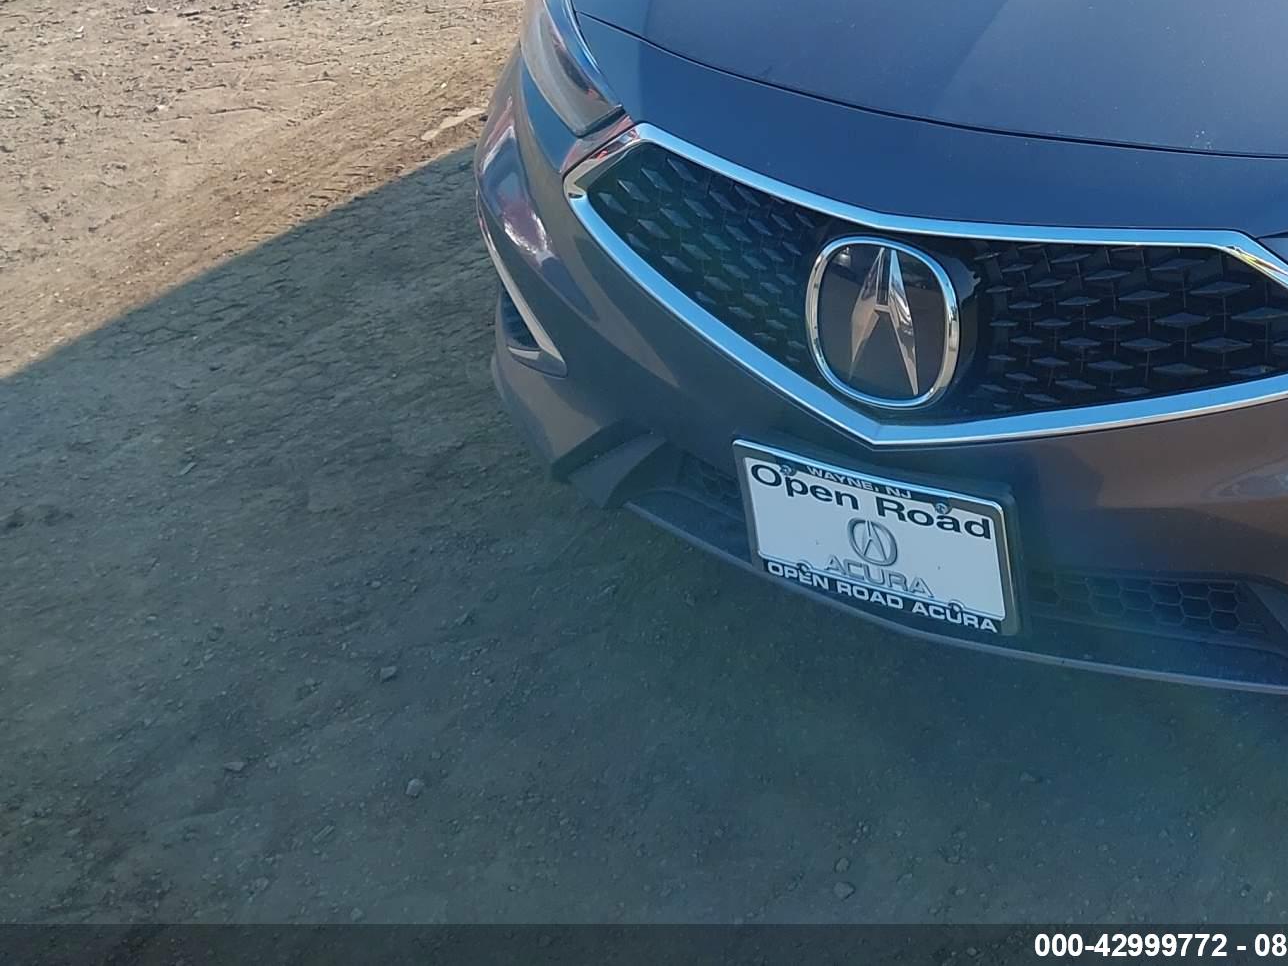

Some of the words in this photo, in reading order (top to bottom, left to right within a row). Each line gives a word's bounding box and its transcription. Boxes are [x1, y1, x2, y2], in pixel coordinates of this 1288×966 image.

[750, 463, 860, 511] Open
[876, 496, 992, 540] Road
[884, 485, 912, 500] NJ
[767, 561, 830, 591] OPEN
[836, 580, 904, 610] ROAD
[911, 601, 998, 634] ACURA
[824, 554, 934, 598] ACURA
